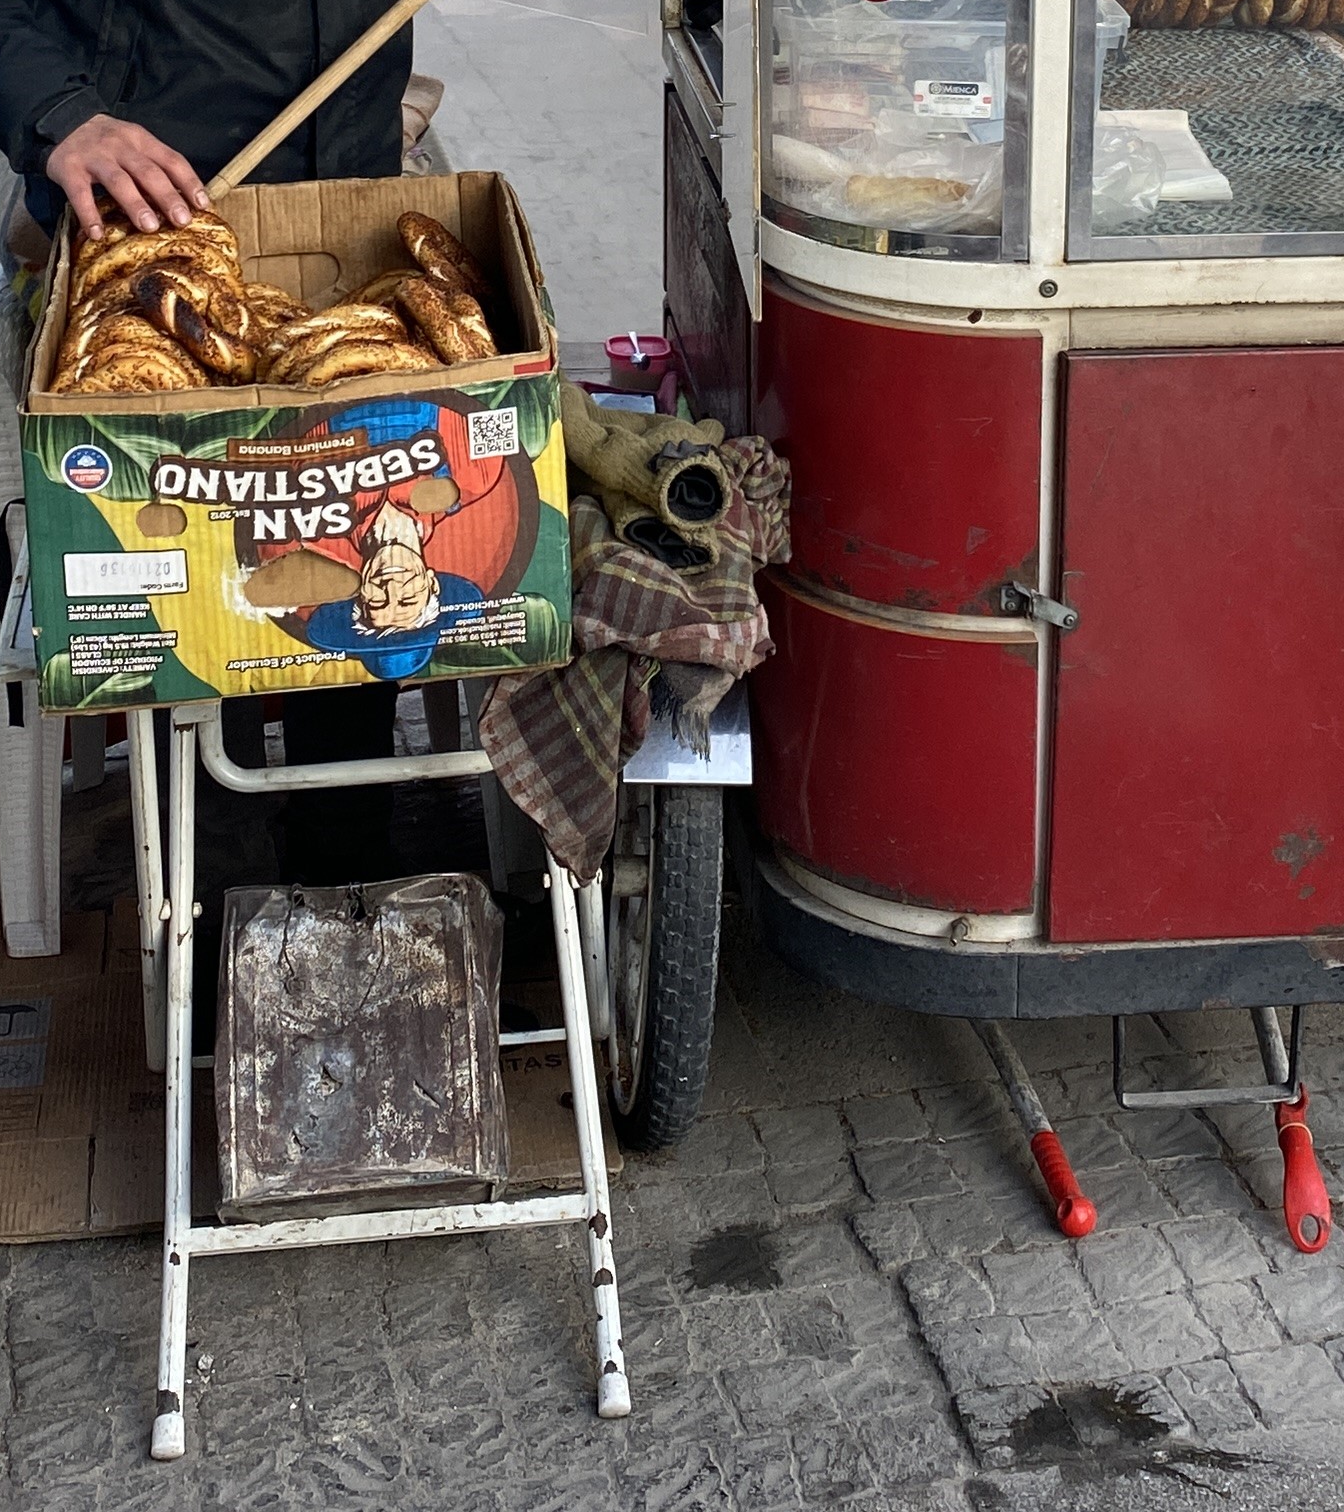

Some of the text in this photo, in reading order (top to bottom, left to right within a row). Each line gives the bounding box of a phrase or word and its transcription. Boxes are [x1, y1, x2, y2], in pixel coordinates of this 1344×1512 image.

[238, 435, 356, 457] Premium Banana
[154, 438, 441, 503] SEBASTIANO
[210, 510, 233, 520] 2012
[252, 502, 353, 542] SAN
[140, 583, 162, 591] Code:
[85, 604, 98, 612] OR
[127, 603, 151, 612] KEEP
[439, 595, 526, 613] www.TUCHOK.com
[68, 610, 147, 621] HANDLE WITH CARE
[455, 616, 486, 627] Ecuador
[75, 651, 102, 659] CLASS
[71, 655, 163, 667] PRODUCT OF ECUADOR
[227, 650, 346, 672] Product of Ecuador
